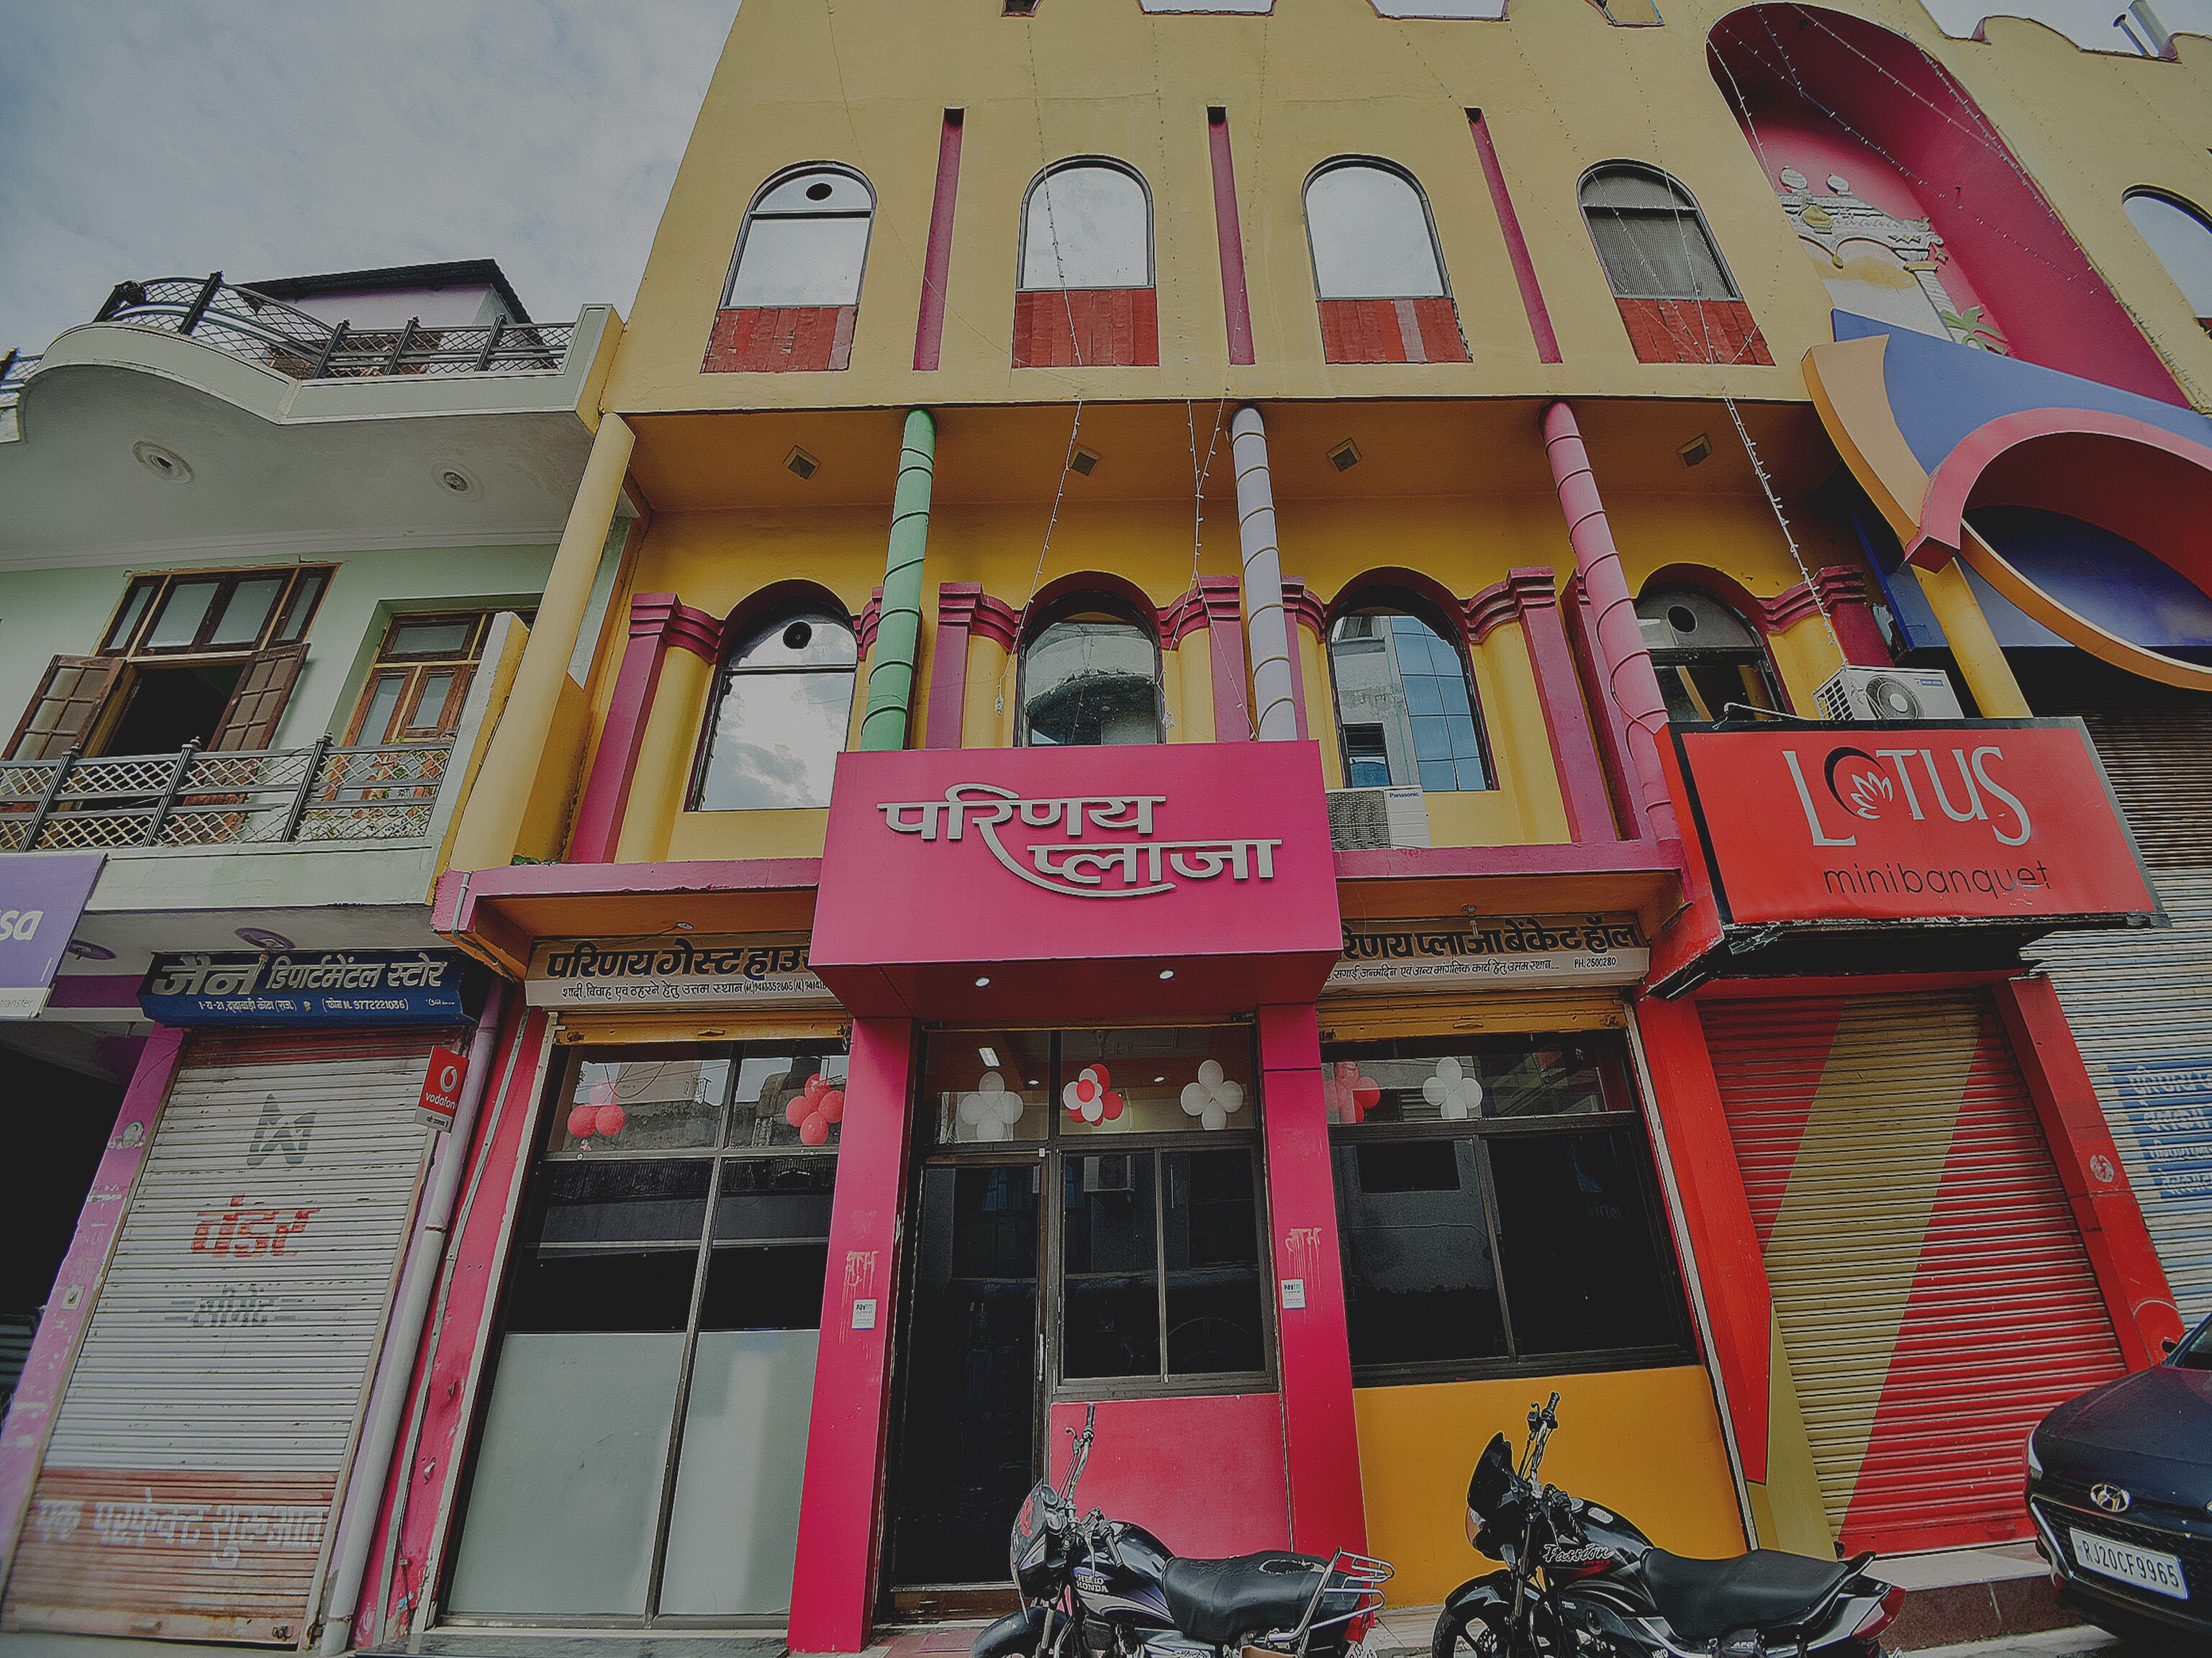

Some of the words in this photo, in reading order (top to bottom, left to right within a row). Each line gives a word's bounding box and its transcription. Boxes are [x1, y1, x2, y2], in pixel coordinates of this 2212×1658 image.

[1782, 746, 2032, 846] LOTUS
[1026, 838, 1282, 884] प्लाजा
[1823, 860, 2052, 899] minibanquet
[547, 941, 659, 979] परिणय
[656, 938, 745, 976] गेस्ट
[1341, 923, 1414, 961] रिणय
[1414, 928, 1503, 958] प्लाजा
[1582, 914, 1642, 955] हॉल
[151, 954, 261, 995] जैन
[266, 953, 386, 989] डिपार्टमेंटल
[387, 952, 448, 987] स्टोर
[1542, 1543, 1615, 1563] Passion
[2082, 1539, 2180, 1587] RJ20CF9965
[1076, 1580, 1109, 1593] HONDA
[1077, 1574, 1105, 1585] HERO
